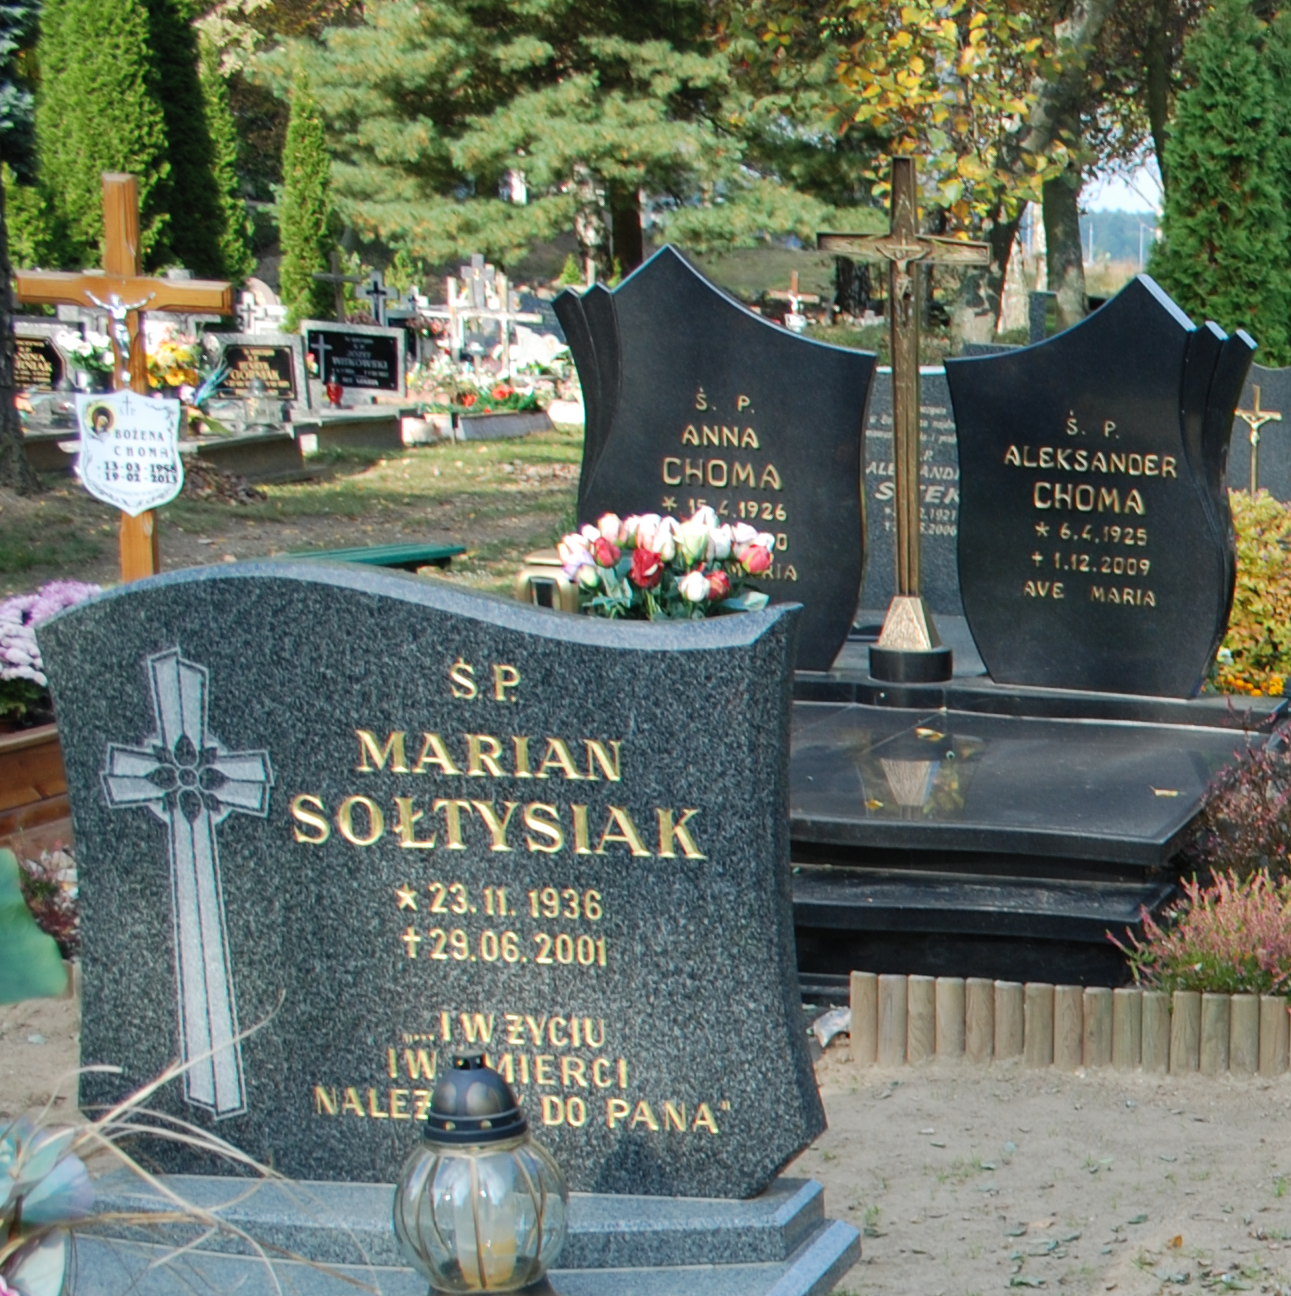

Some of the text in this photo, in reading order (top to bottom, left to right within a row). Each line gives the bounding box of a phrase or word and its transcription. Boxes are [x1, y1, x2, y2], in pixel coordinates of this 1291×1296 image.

[114, 445, 169, 458] CHOMA
[682, 424, 760, 449] ANNA
[662, 457, 783, 490] CHOMA
[1004, 445, 1177, 478] ALEKSANDER
[1034, 481, 1147, 515] CHOMA
[1024, 580, 1156, 607] AVE MARIA
[354, 728, 623, 782] MARIAN
[291, 793, 708, 860] SOŁTYSIAK
[505, 1013, 605, 1048] ŻYCIU
[404, 1048, 437, 1080] W
[488, 1053, 629, 1089] MIERCI
[542, 1096, 586, 1127] DO
